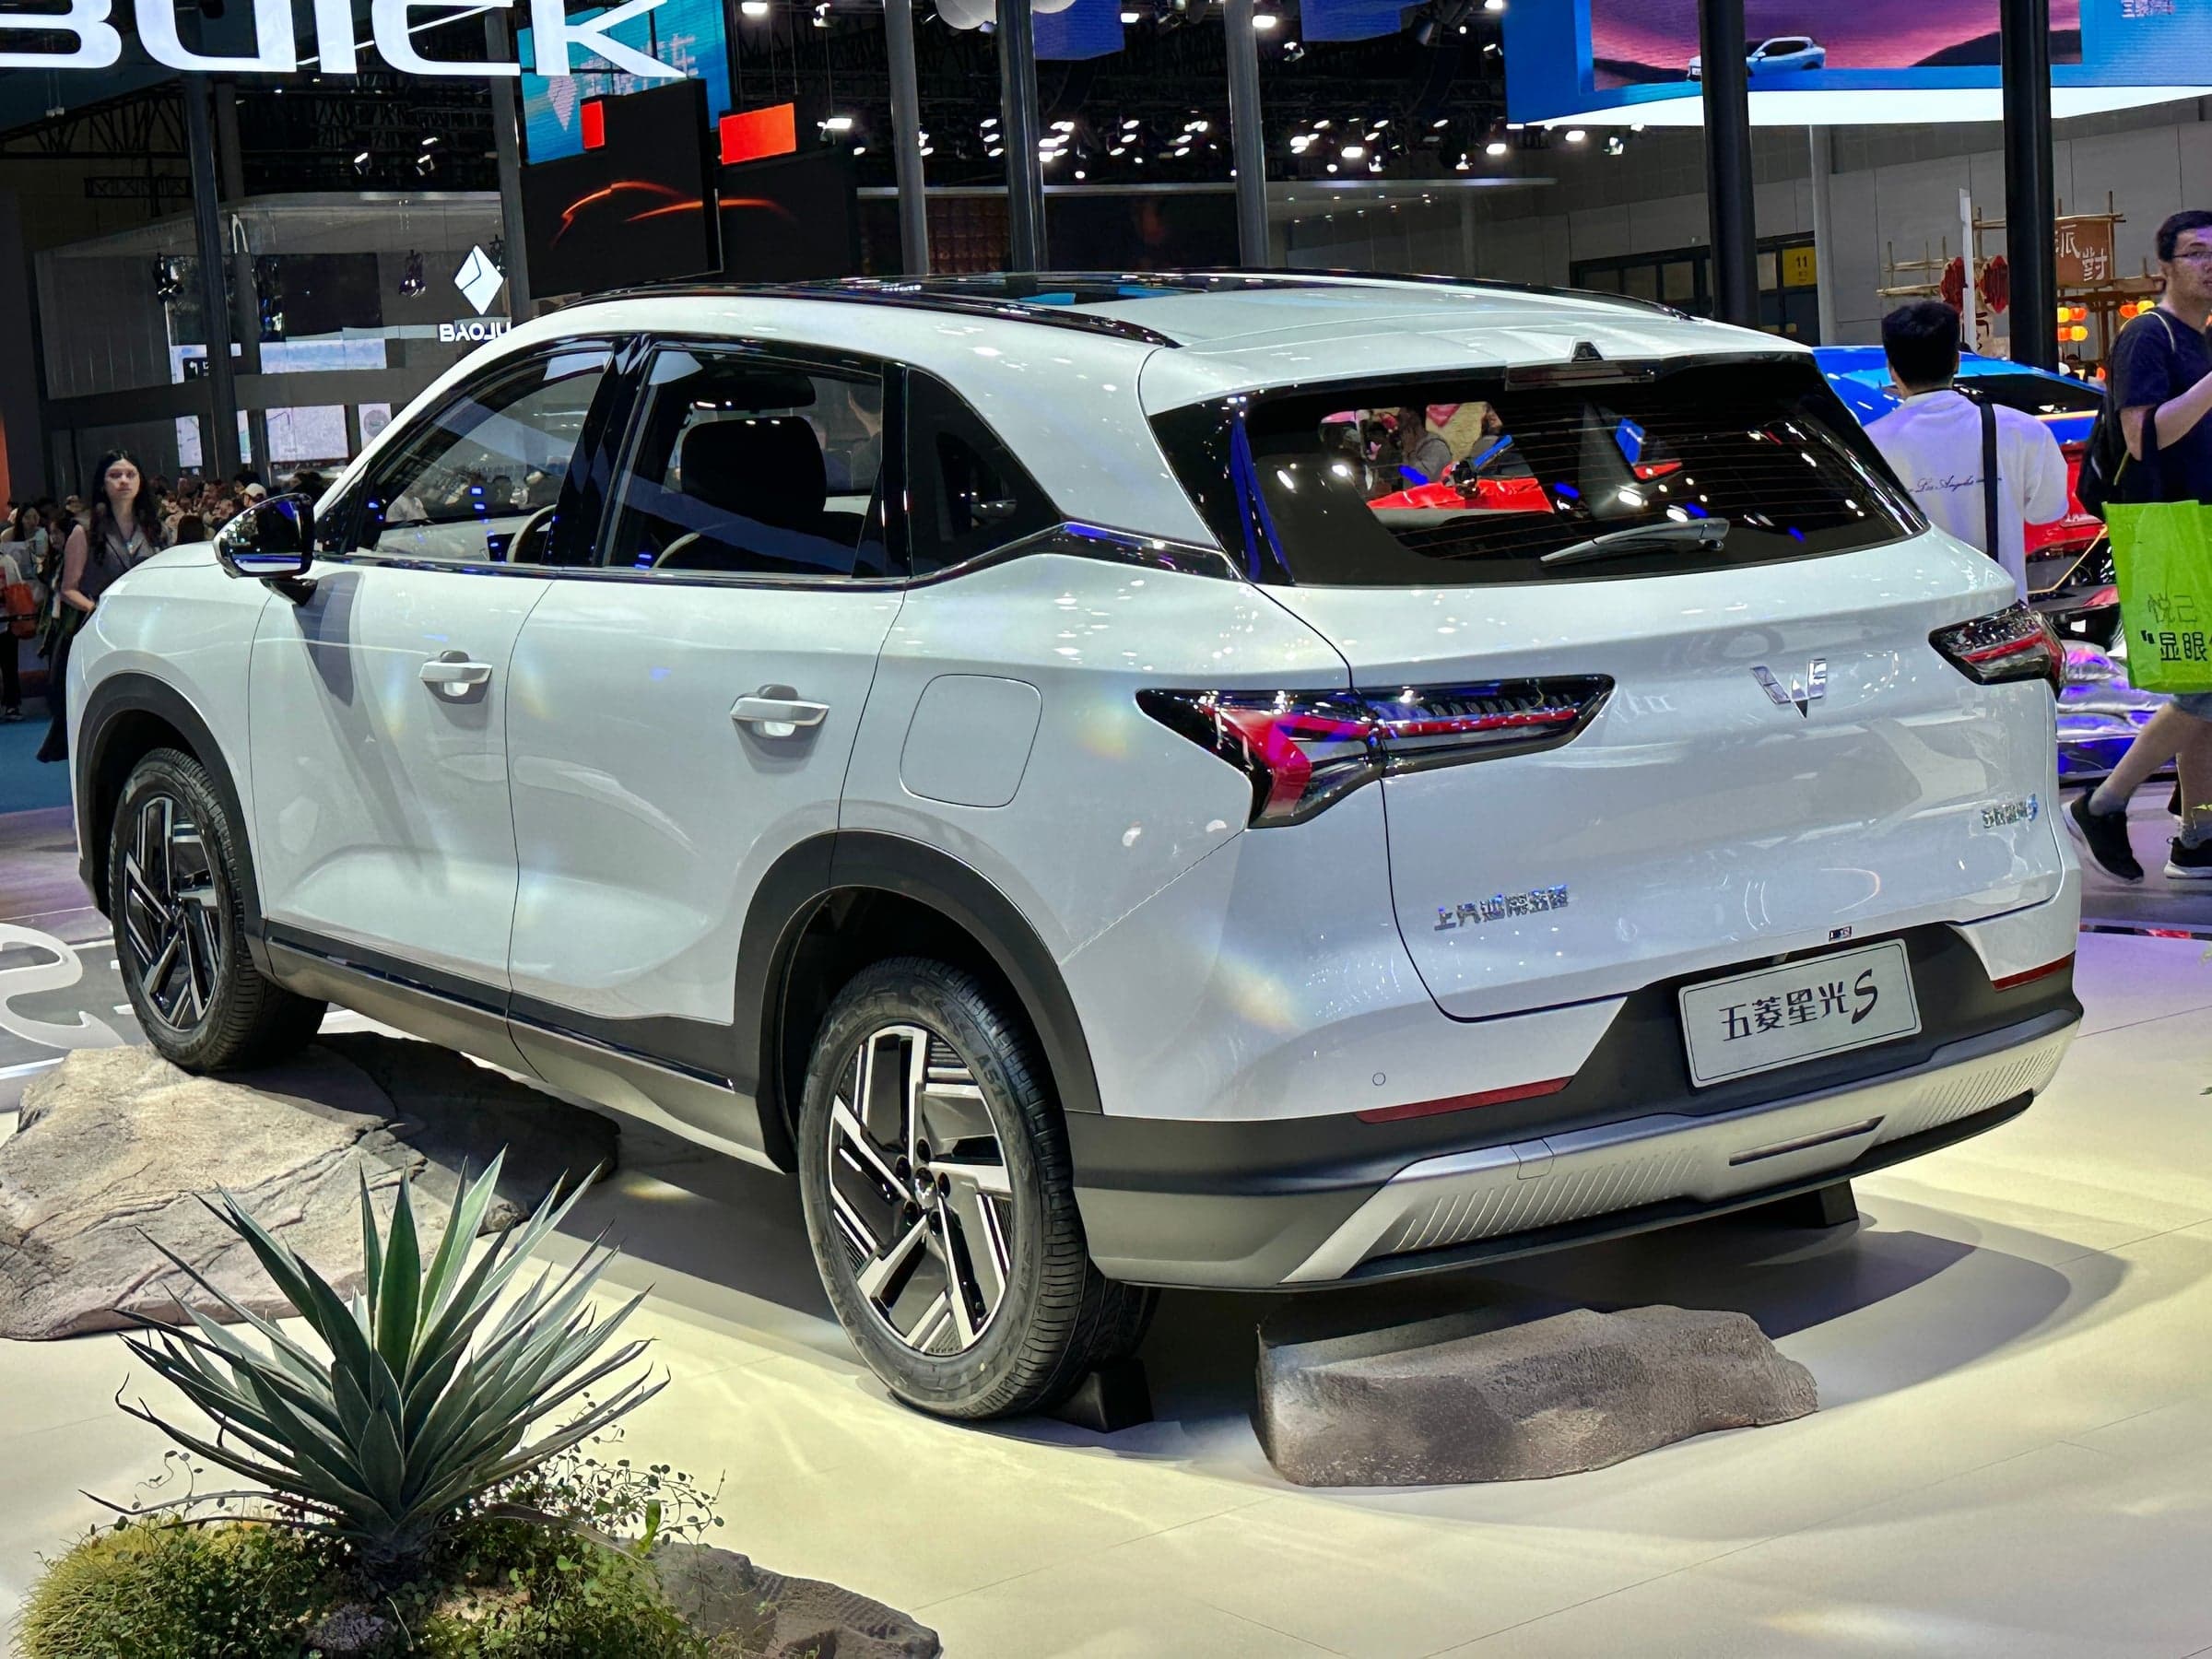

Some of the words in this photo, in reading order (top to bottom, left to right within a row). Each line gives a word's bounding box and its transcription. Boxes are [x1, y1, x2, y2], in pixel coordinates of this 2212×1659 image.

[0, 0, 688, 77] BUICK
[1795, 255, 1807, 268] 11
[1718, 968, 1878, 1041] 五菱星光S
